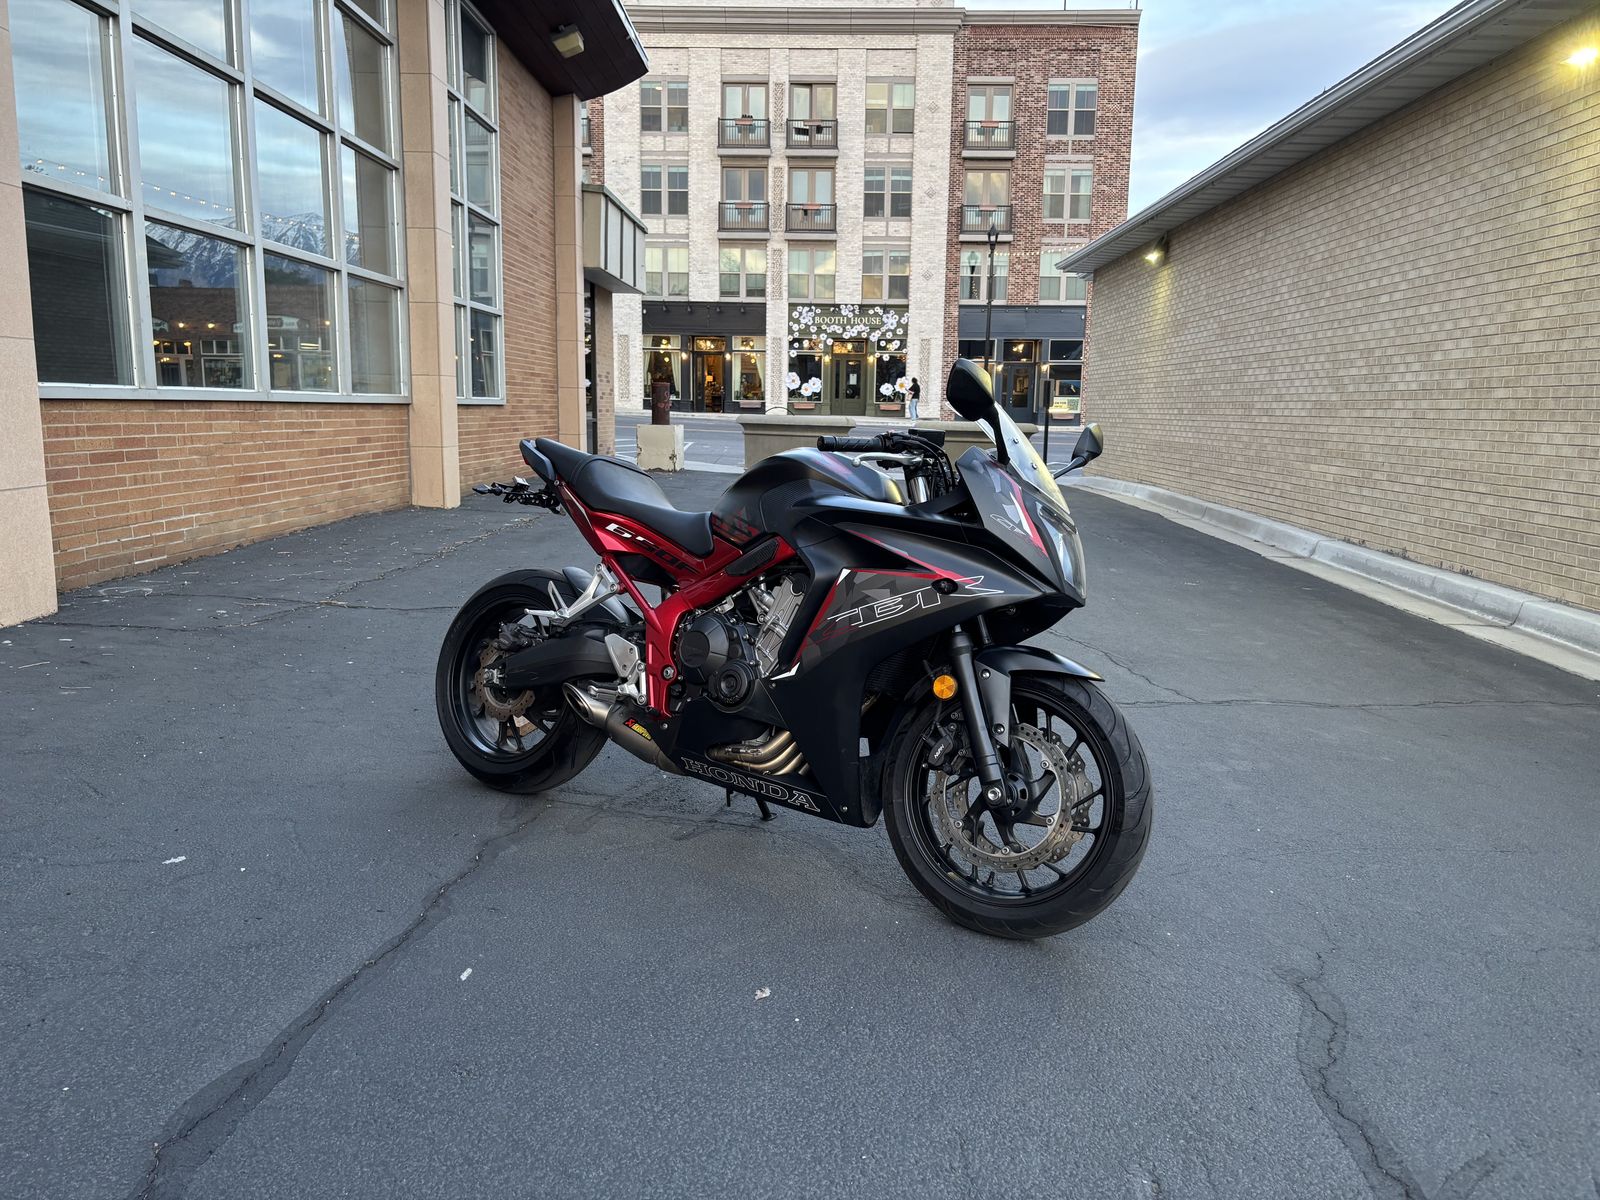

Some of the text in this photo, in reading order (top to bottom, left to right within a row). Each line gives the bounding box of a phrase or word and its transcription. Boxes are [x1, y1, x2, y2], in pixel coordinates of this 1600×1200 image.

[814, 316, 882, 325] BOOTH HOUSE
[680, 756, 821, 813] HONDA
